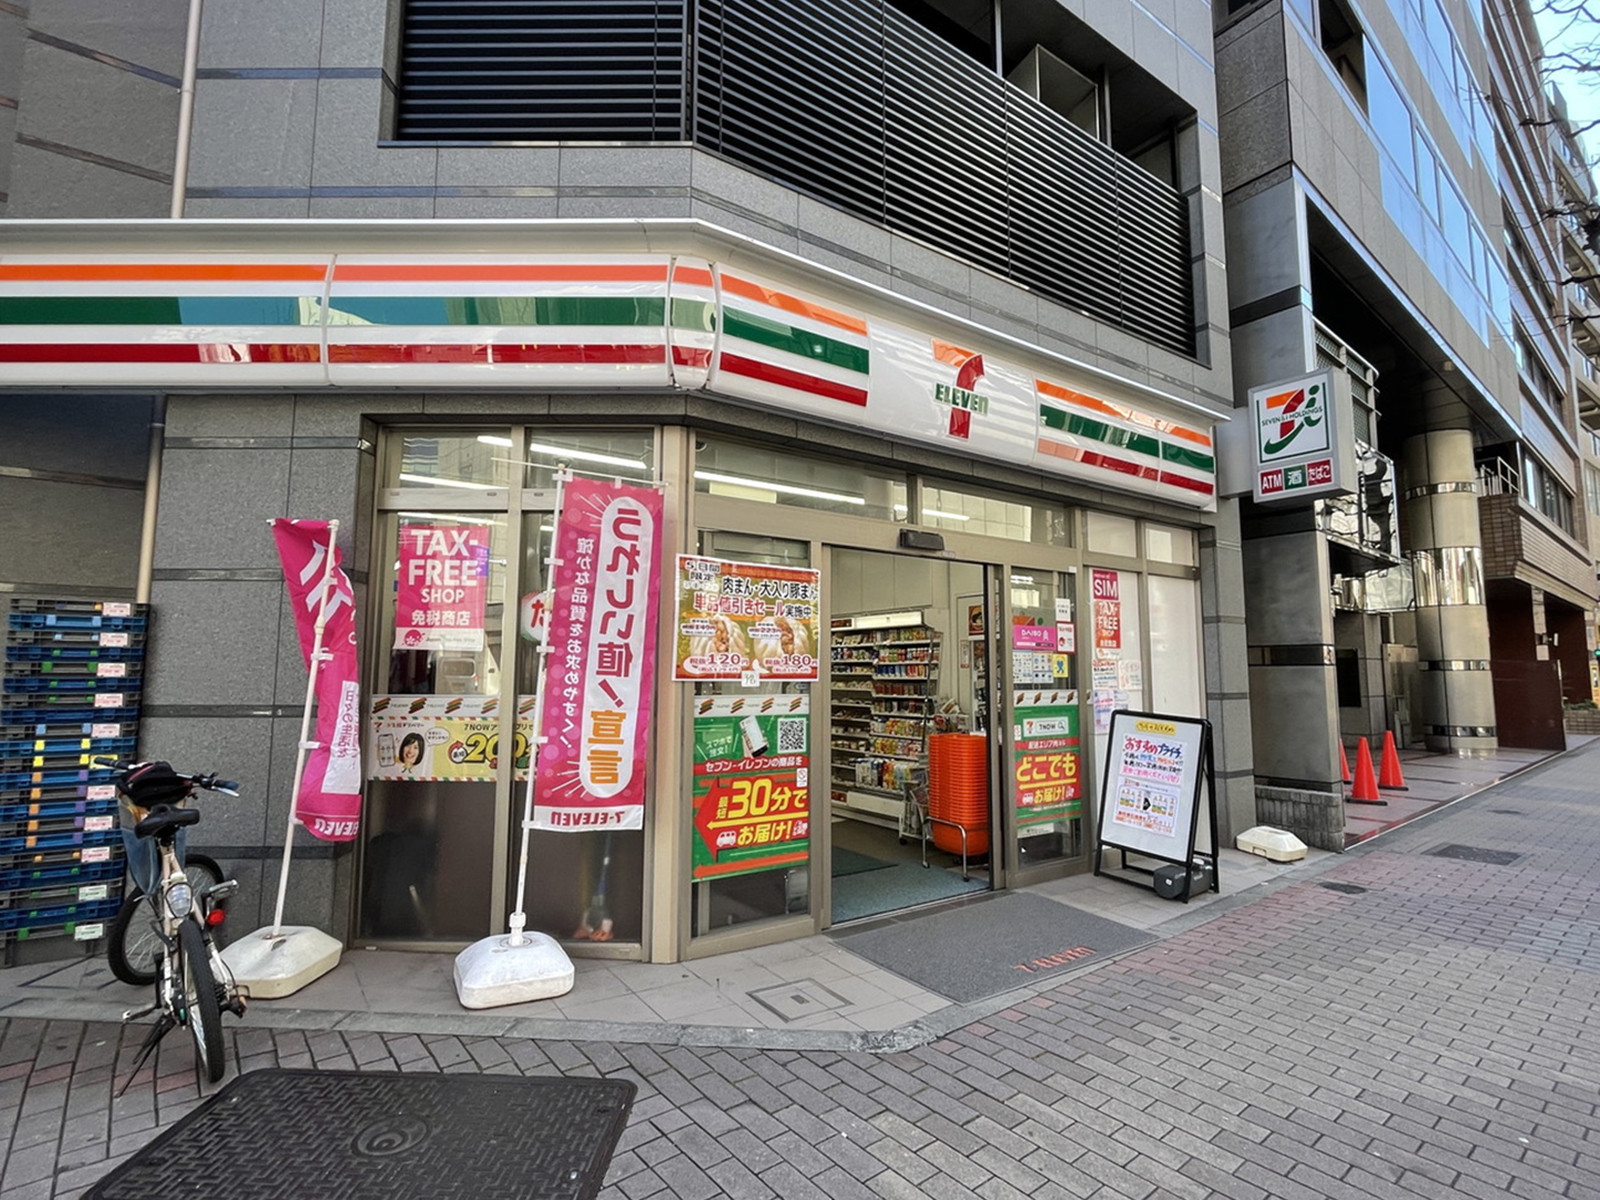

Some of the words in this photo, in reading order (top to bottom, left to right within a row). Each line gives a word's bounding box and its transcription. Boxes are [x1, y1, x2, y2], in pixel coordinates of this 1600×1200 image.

[1261, 415, 1281, 427] SEVEN
[1289, 406, 1323, 420] HOLDINGS
[1287, 469, 1303, 486] 酒
[1308, 464, 1332, 480] たばこ
[1262, 474, 1282, 490] ATM
[411, 529, 478, 556] TAX-
[408, 559, 478, 586] FREE
[421, 588, 464, 604] SHOP
[1094, 579, 1118, 598] SIM
[411, 610, 471, 626] 免税商店
[1016, 752, 1076, 782] どこでも
[728, 777, 808, 818] 30分で
